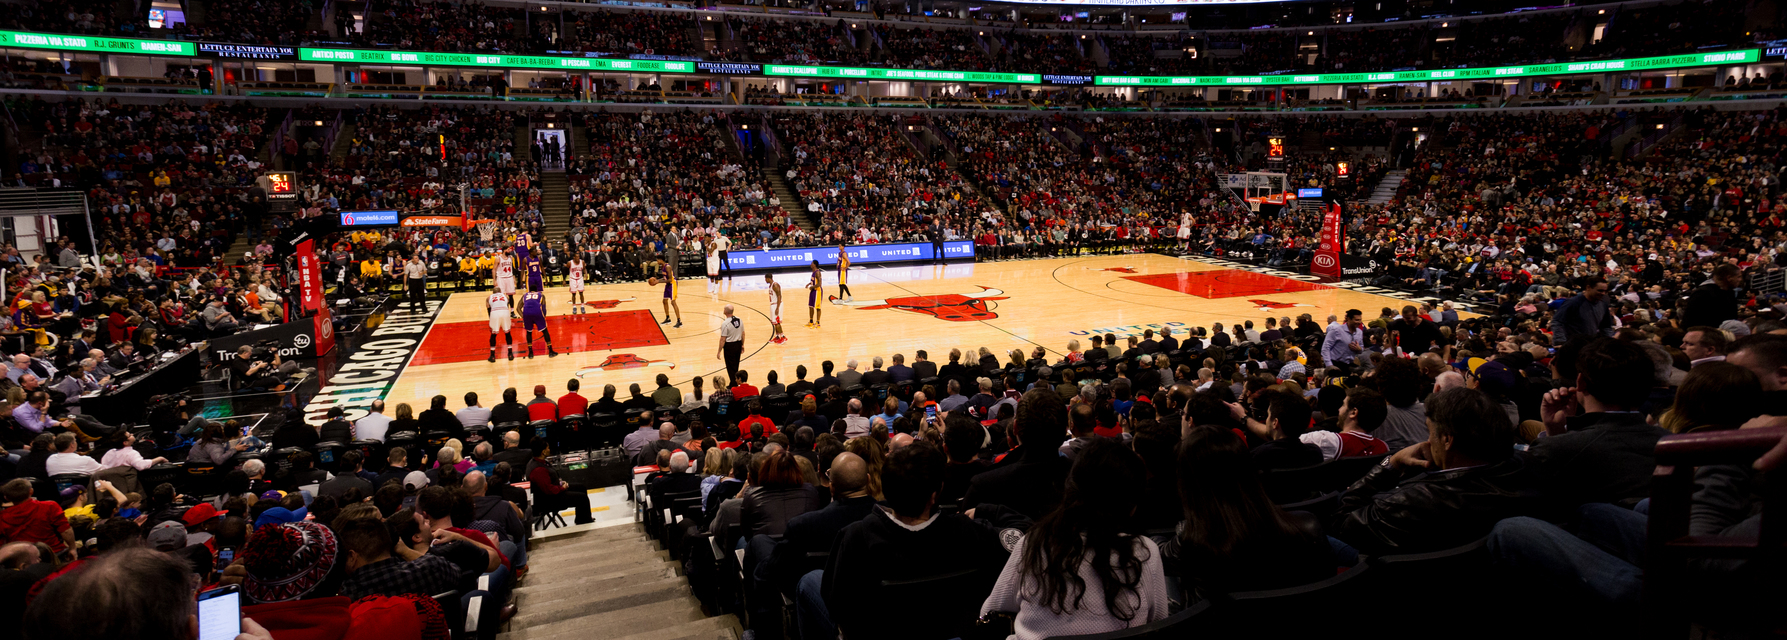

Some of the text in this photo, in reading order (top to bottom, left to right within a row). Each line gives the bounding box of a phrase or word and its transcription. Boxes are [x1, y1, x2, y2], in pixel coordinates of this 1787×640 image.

[15, 34, 48, 46] PIZZERIA
[49, 37, 63, 46] VIA
[64, 38, 86, 47] STATO
[94, 40, 107, 48] R.J.
[108, 41, 135, 50] GRUNTS
[141, 42, 182, 52] RAMEN-SAN
[200, 43, 236, 52] LETTUCE
[236, 45, 278, 54] ENTERTAIN
[312, 50, 334, 59] ANTICO
[335, 51, 354, 60] POSTO
[361, 52, 384, 60] BEATRIX
[391, 53, 400, 61] BIG
[402, 54, 418, 62] BOWL
[520, 58, 556, 66] BA-BA-REEBA!
[612, 60, 632, 68] EVEREST
[1568, 62, 1590, 71] SHAW'S
[1590, 62, 1605, 70] CRAB
[1606, 60, 1624, 69] HOUSE
[1630, 60, 1650, 68] STELLA
[1652, 58, 1670, 66] BARRA
[1672, 56, 1696, 64] PIZZERIA
[1704, 54, 1726, 62] STUDIO
[1726, 52, 1746, 60] PARIS
[1270, 145, 1282, 156] 24
[269, 174, 288, 182] 46.1
[274, 182, 290, 192] 24
[344, 212, 354, 225] 6
[1318, 256, 1331, 265] KIA
[302, 268, 312, 302] NBA TV
[1070, 322, 1186, 336] UNITED
[303, 338, 416, 426] CHICAGO
